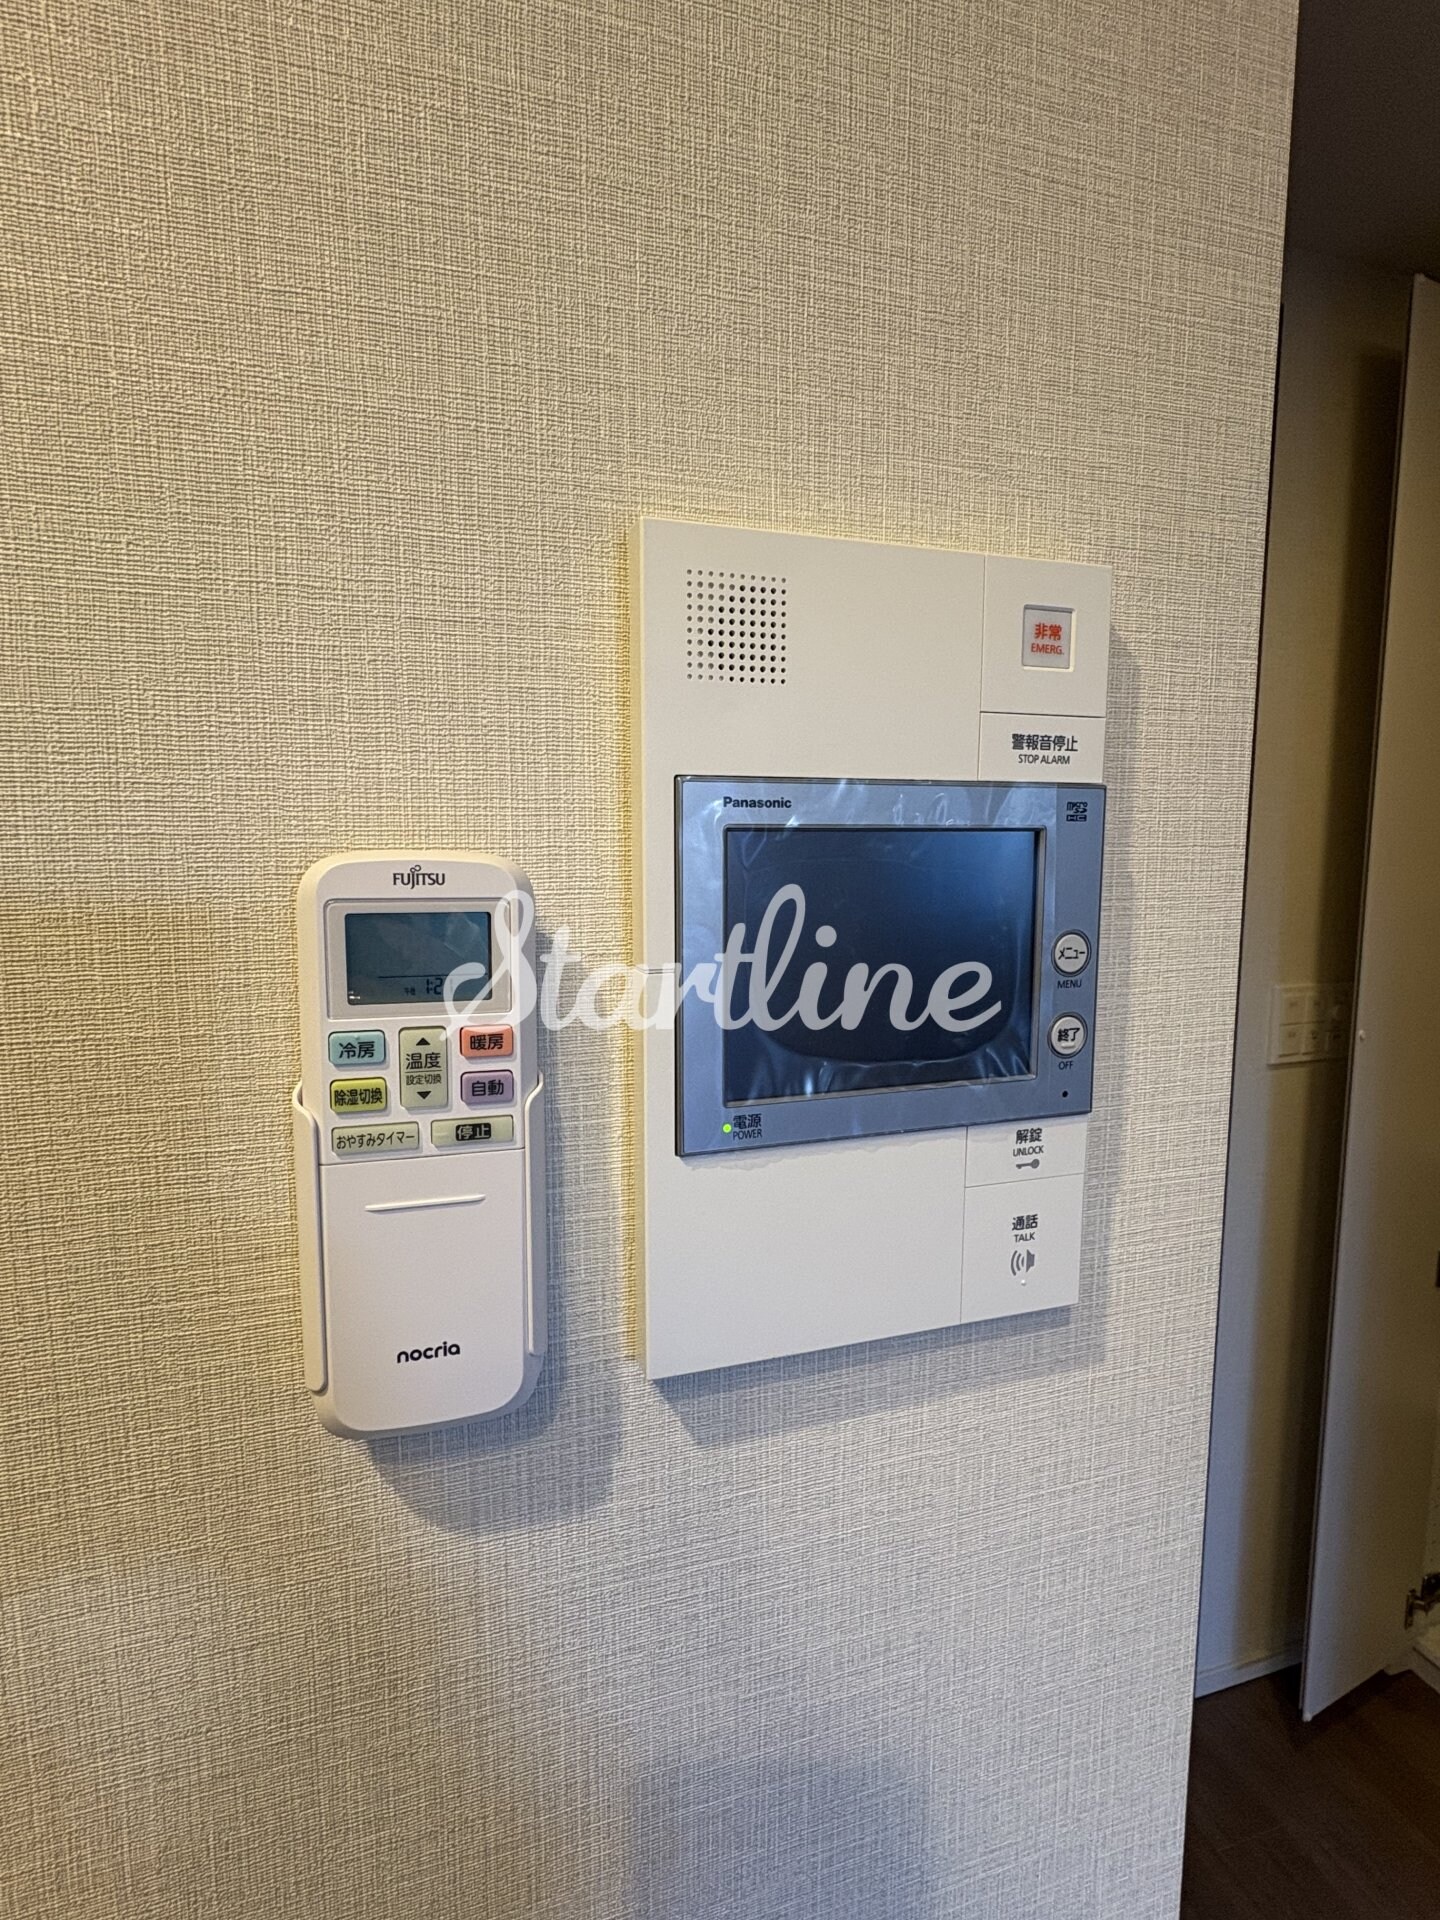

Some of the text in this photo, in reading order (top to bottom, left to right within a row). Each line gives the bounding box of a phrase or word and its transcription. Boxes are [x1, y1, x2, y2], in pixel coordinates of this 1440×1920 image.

[1034, 623, 1062, 641] 非常
[1030, 643, 1064, 655] EMERG.
[1011, 733, 1078, 752] 警報音停止
[1018, 754, 1070, 765] STOP ALARM
[723, 796, 792, 808] Panasonic
[393, 864, 446, 889] FUJITSU
[1058, 947, 1085, 960] メニュー
[1057, 979, 1082, 989] MENU
[470, 1033, 503, 1051] 暖房
[1057, 1027, 1080, 1042] 終了
[338, 1041, 375, 1059] 冷房
[405, 1052, 442, 1070] 温度
[1058, 1061, 1074, 1070] OFF
[405, 1073, 442, 1085] 設定切換
[471, 1080, 504, 1097] 自動
[334, 1087, 383, 1107] 除湿切換
[733, 1113, 762, 1129] 電源
[336, 1131, 415, 1149] おやすみタイマー
[457, 1124, 490, 1140] 停止
[733, 1129, 763, 1140] POWER
[1015, 1127, 1043, 1145] 解錠
[1013, 1145, 1044, 1157] UNLOCK
[1012, 1213, 1039, 1231] 通話
[1014, 1232, 1036, 1243] TALK
[397, 1341, 461, 1363] nocria
